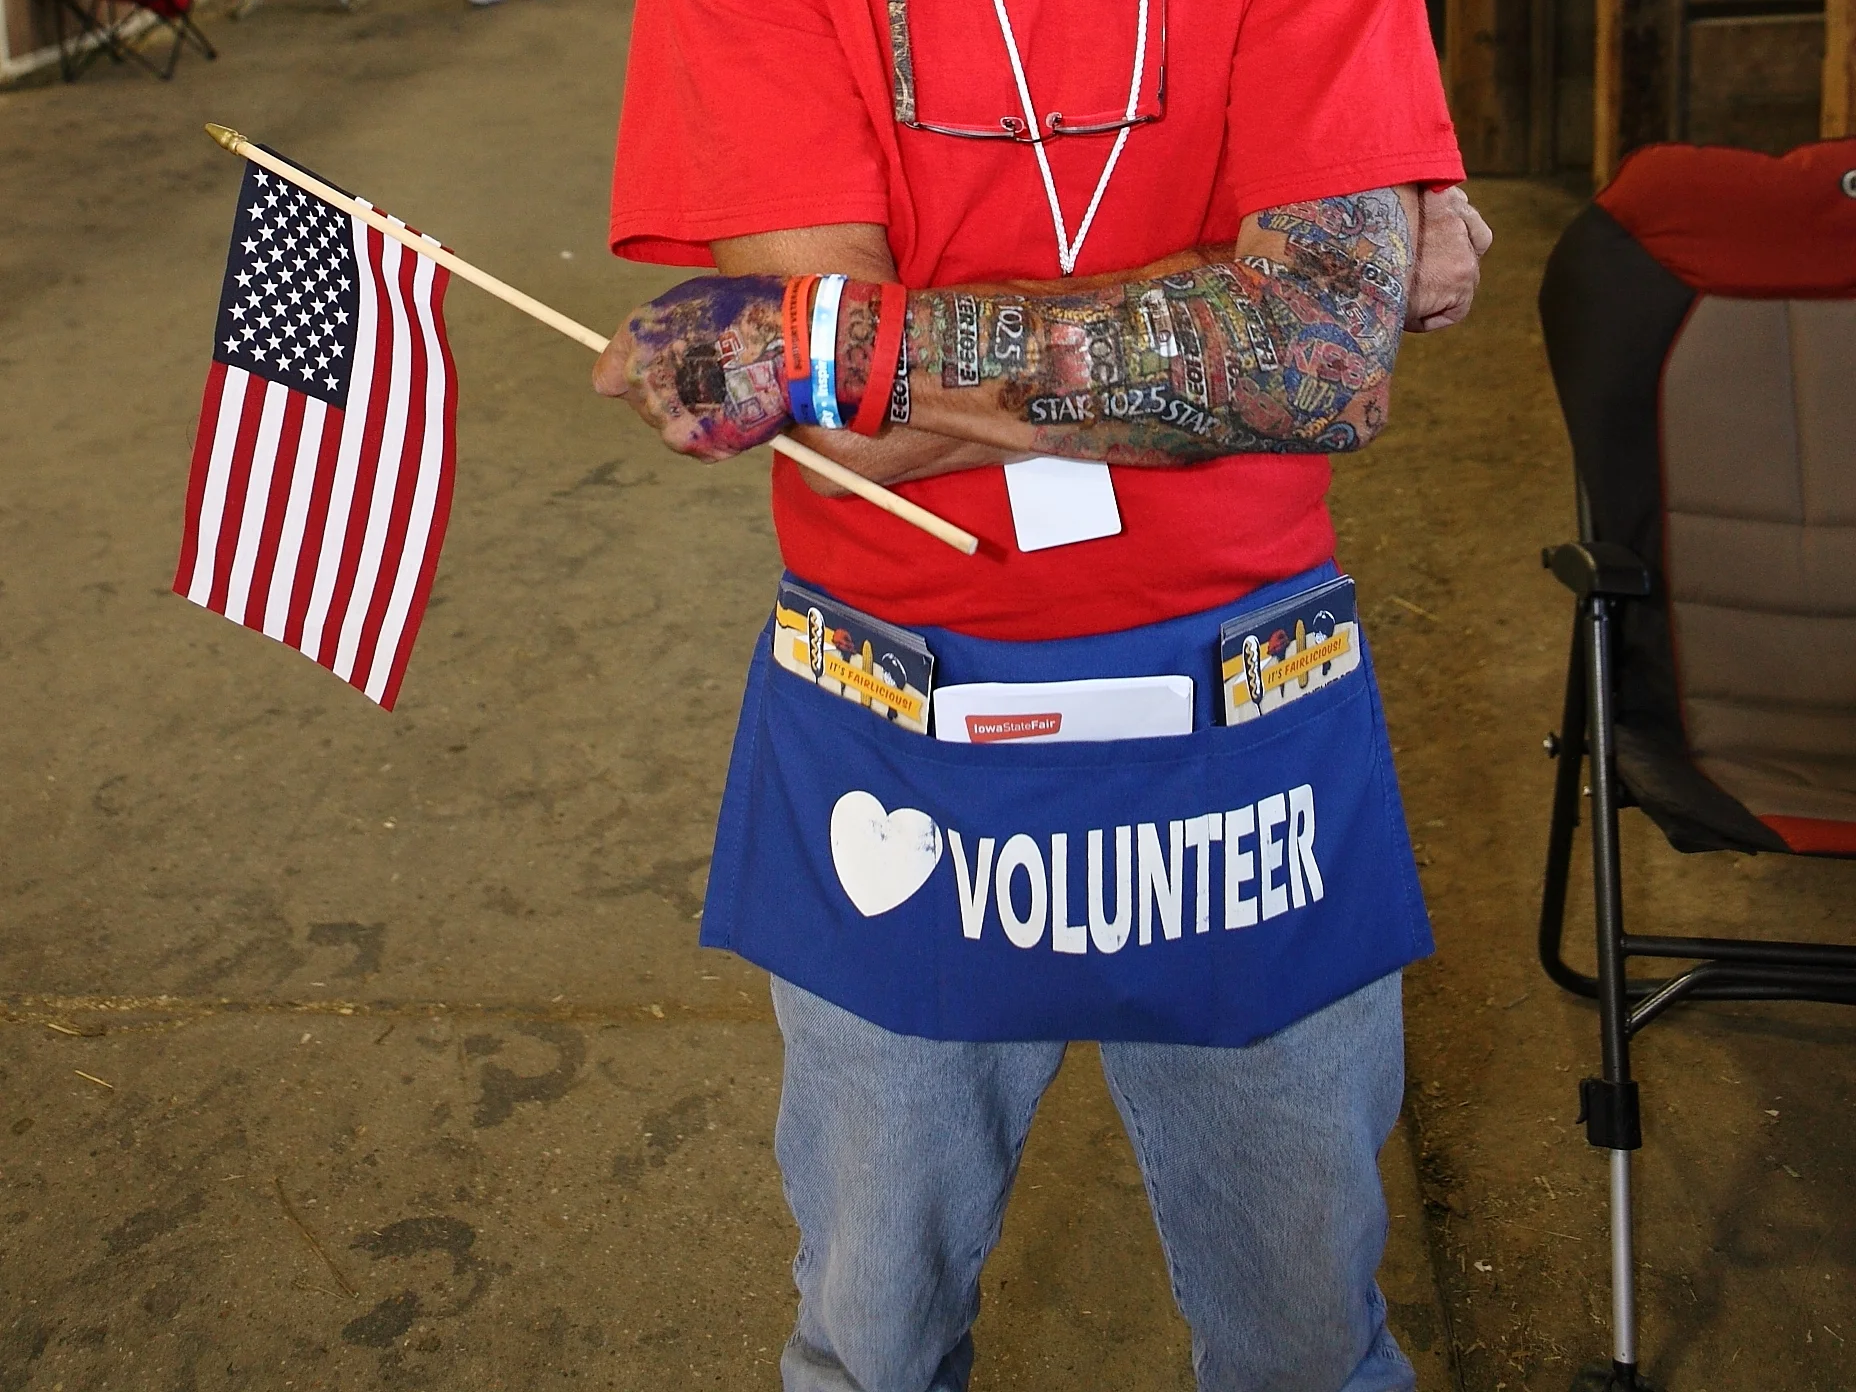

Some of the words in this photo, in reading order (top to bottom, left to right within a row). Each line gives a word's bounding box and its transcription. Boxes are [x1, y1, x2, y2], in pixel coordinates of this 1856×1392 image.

[994, 305, 1024, 360] 102.5
[1031, 394, 1095, 421] STAR
[1102, 386, 1167, 416] 102.5
[1267, 670, 1283, 685] IT'S
[1284, 638, 1342, 675] FAIRLICIOUS!
[829, 662, 846, 675] IT'S
[847, 671, 913, 711] FAIRLICIOUS!
[973, 718, 1056, 734] IowaStateFair
[947, 783, 1324, 954] VOLUNTEER
